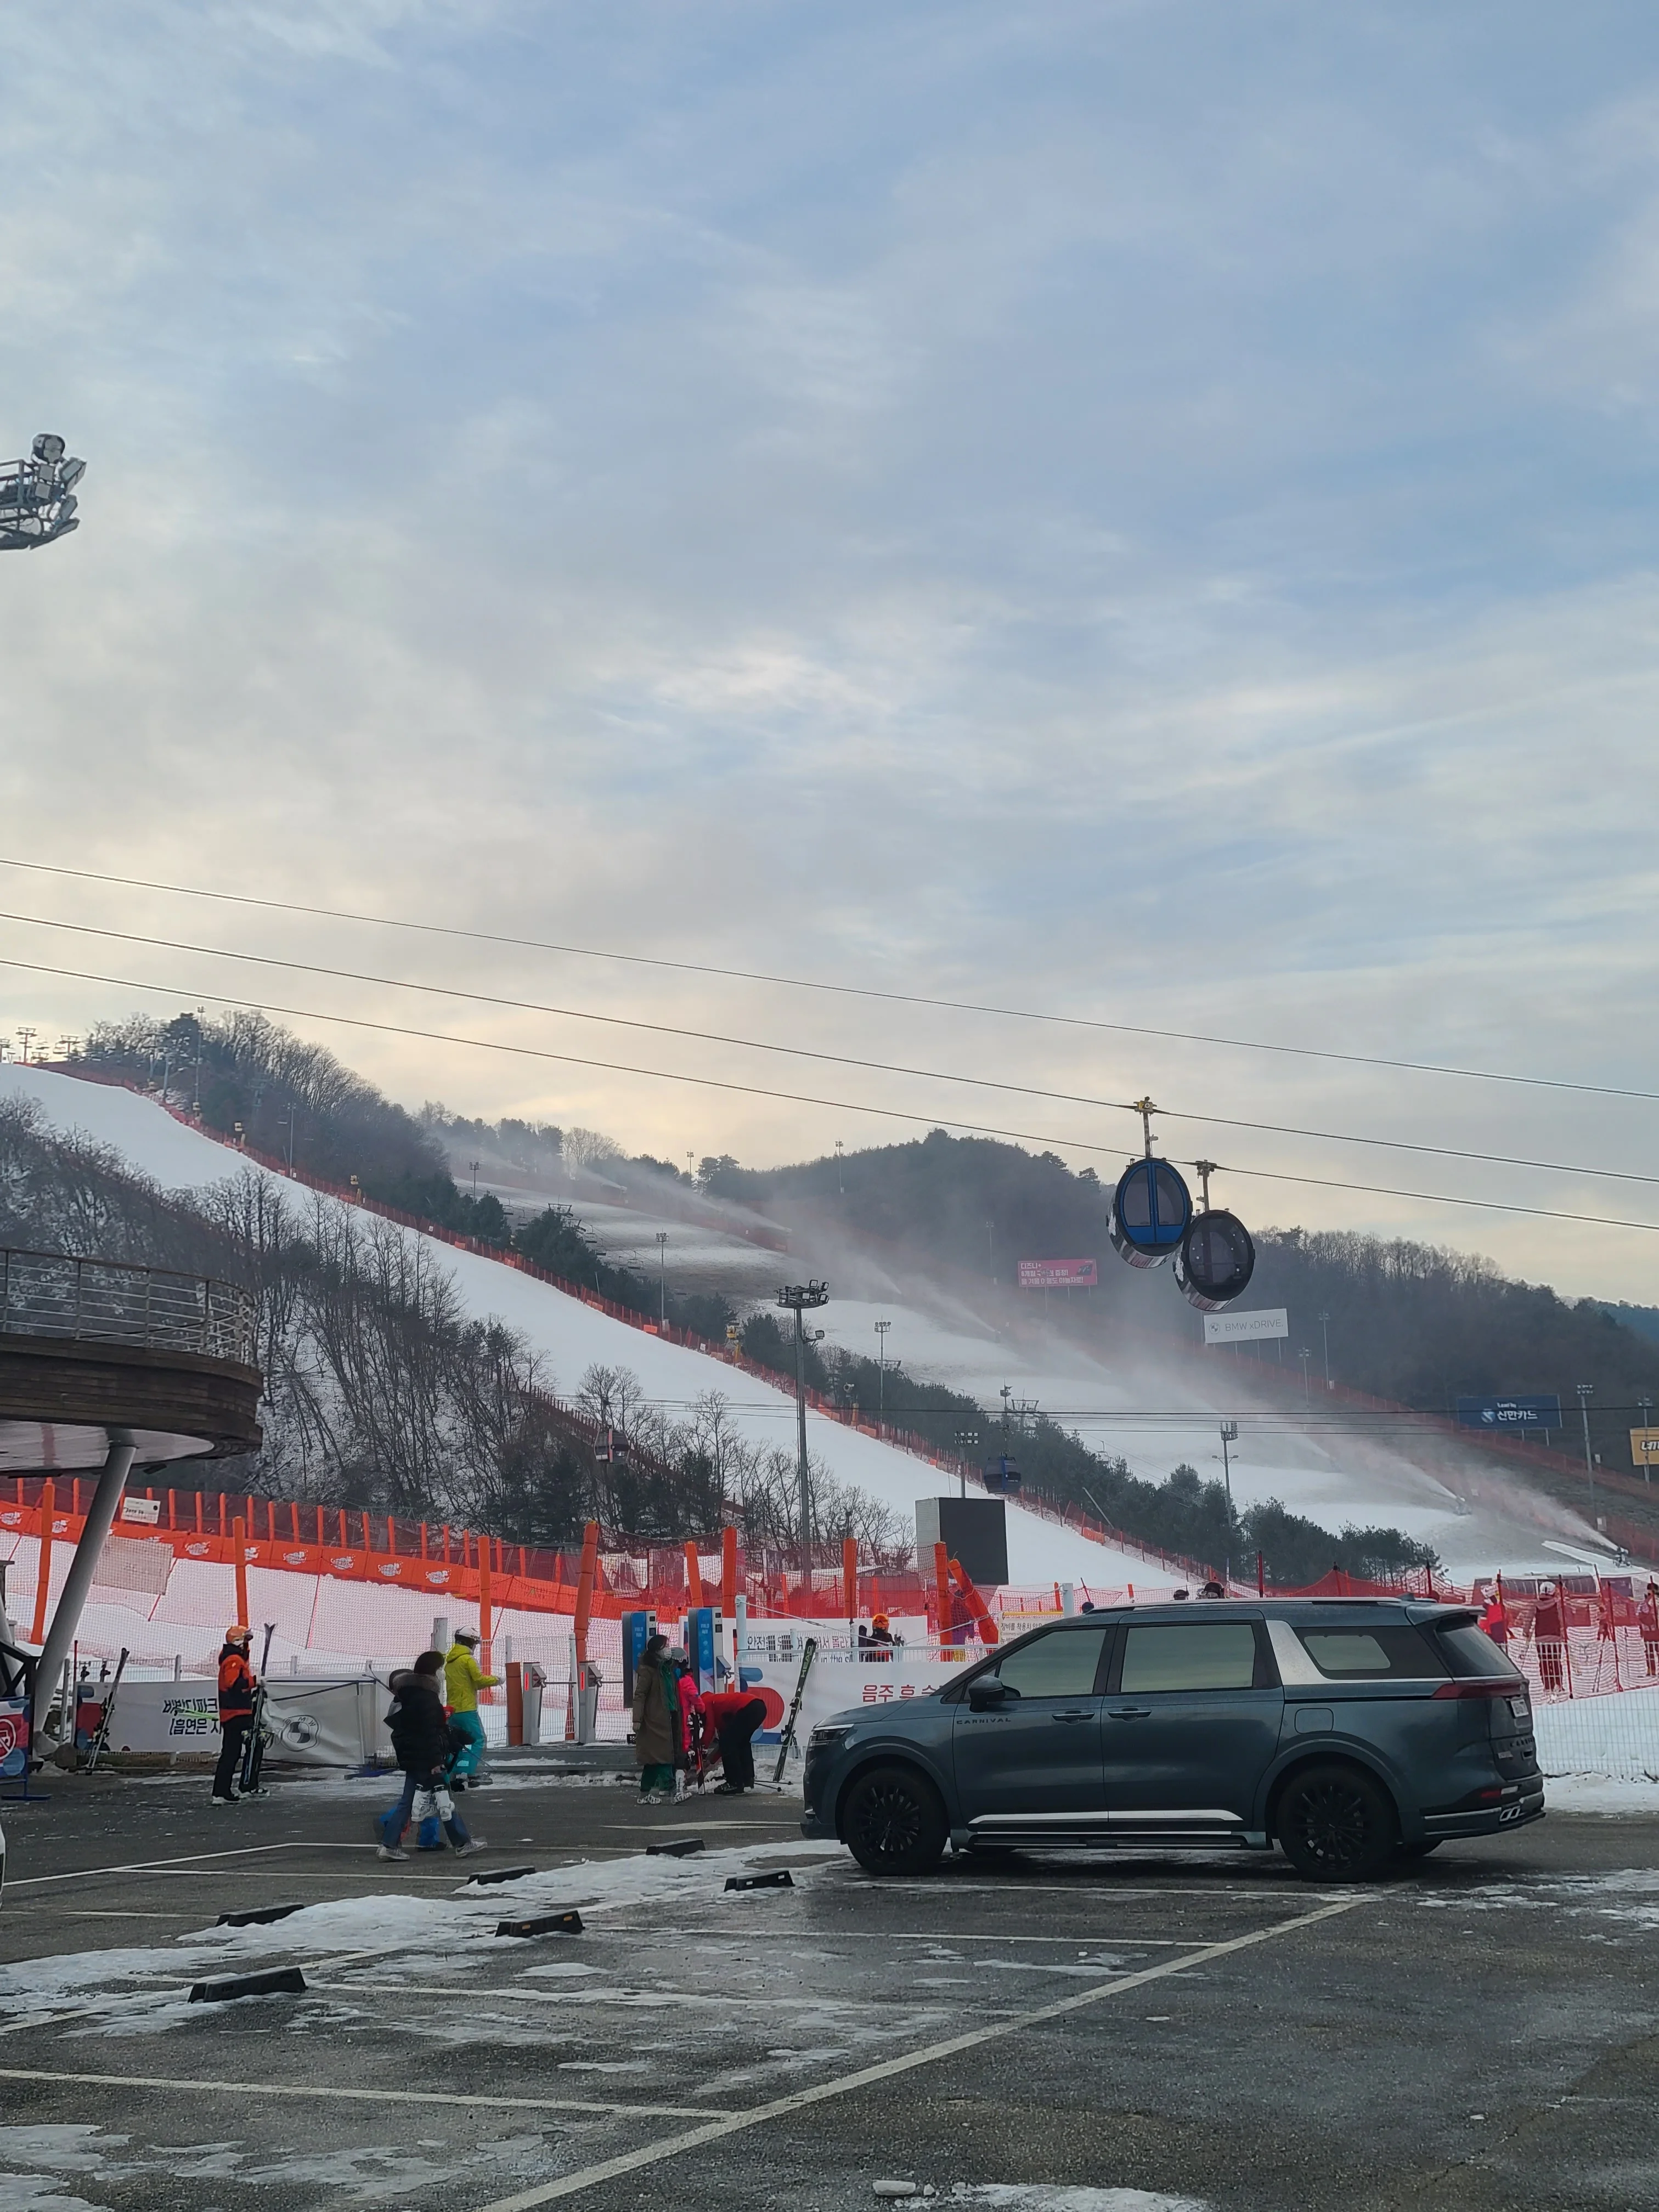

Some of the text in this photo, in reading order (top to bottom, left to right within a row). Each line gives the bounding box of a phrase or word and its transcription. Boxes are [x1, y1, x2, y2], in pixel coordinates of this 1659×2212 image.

[1225, 1322, 1247, 1331] BMW
[1497, 1410, 1538, 1421] 신한카드
[1001, 1623, 1015, 1631] 장비를
[1017, 1622, 1031, 1631] 착용치
[801, 1645, 812, 1678] HEAD
[862, 1685, 894, 1702] 음주
